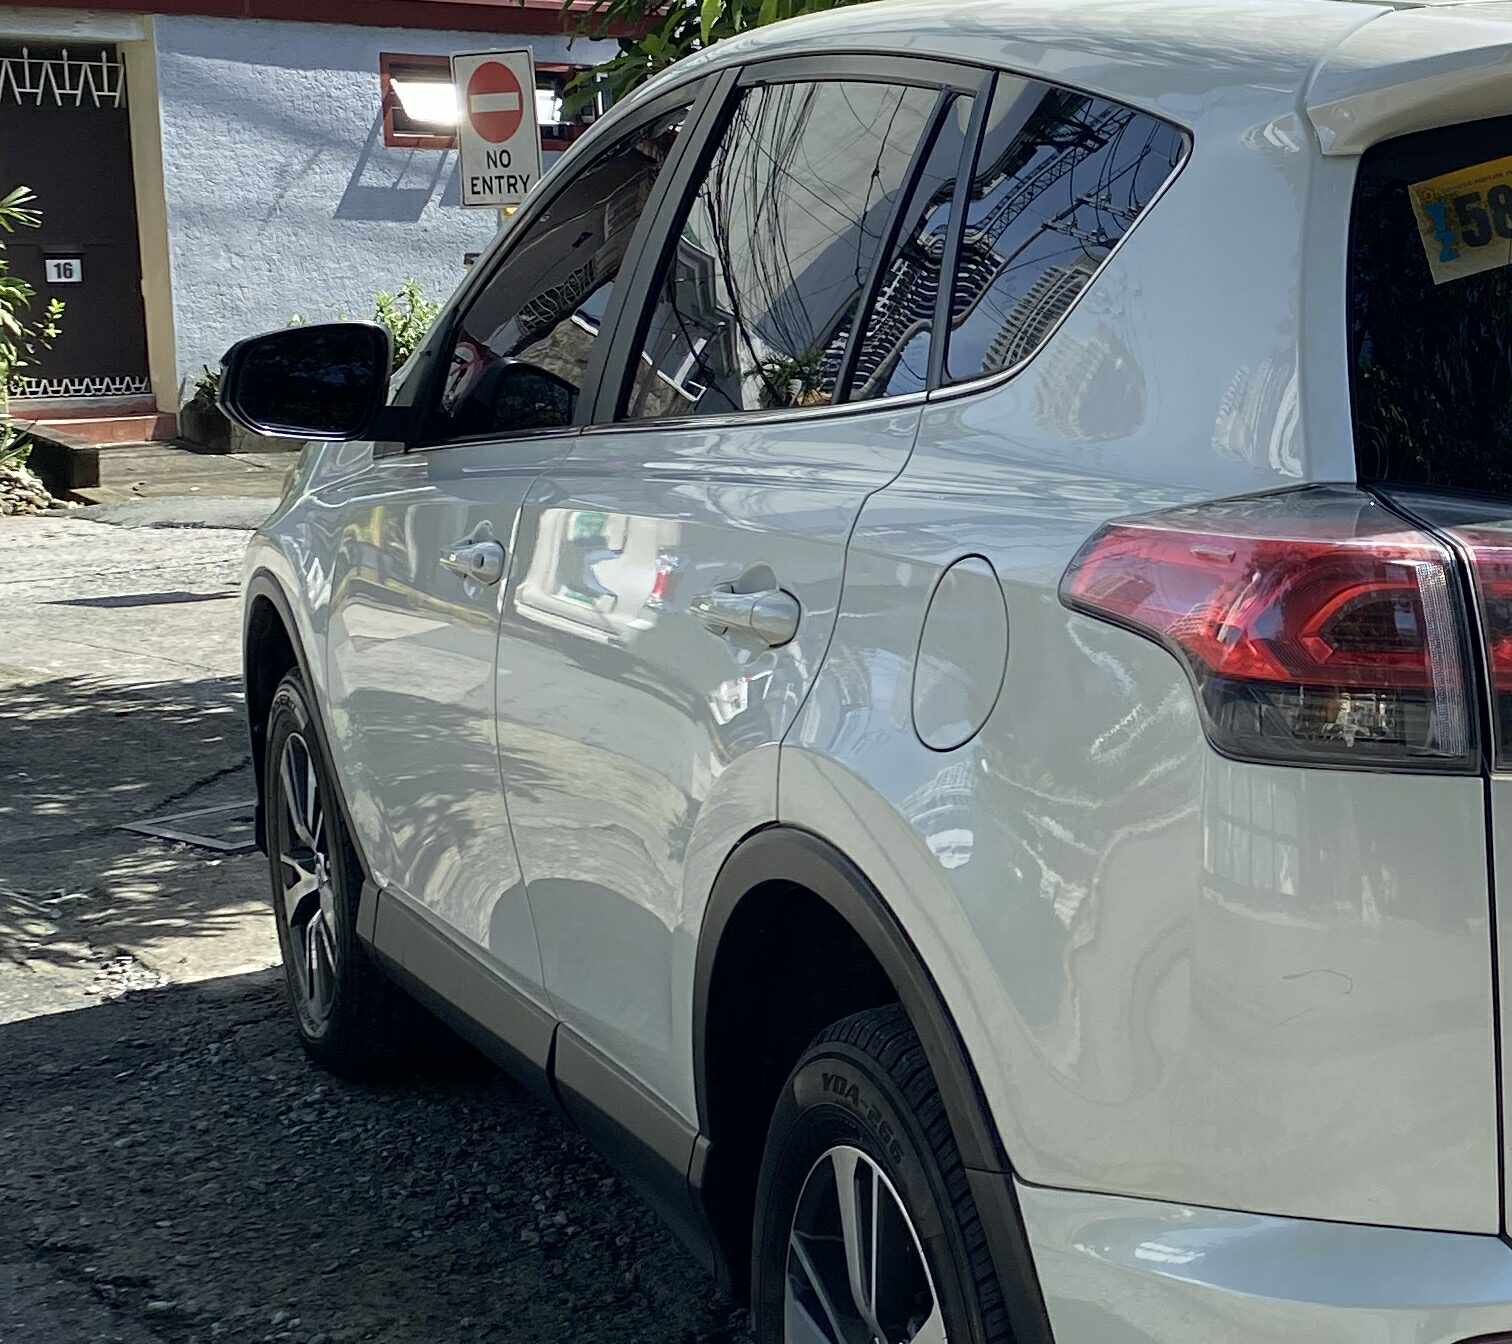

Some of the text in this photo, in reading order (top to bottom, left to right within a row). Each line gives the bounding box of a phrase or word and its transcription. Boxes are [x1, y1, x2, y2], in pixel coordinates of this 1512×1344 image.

[486, 149, 511, 169] NO
[471, 174, 530, 195] ENTRY
[53, 262, 73, 279] 16
